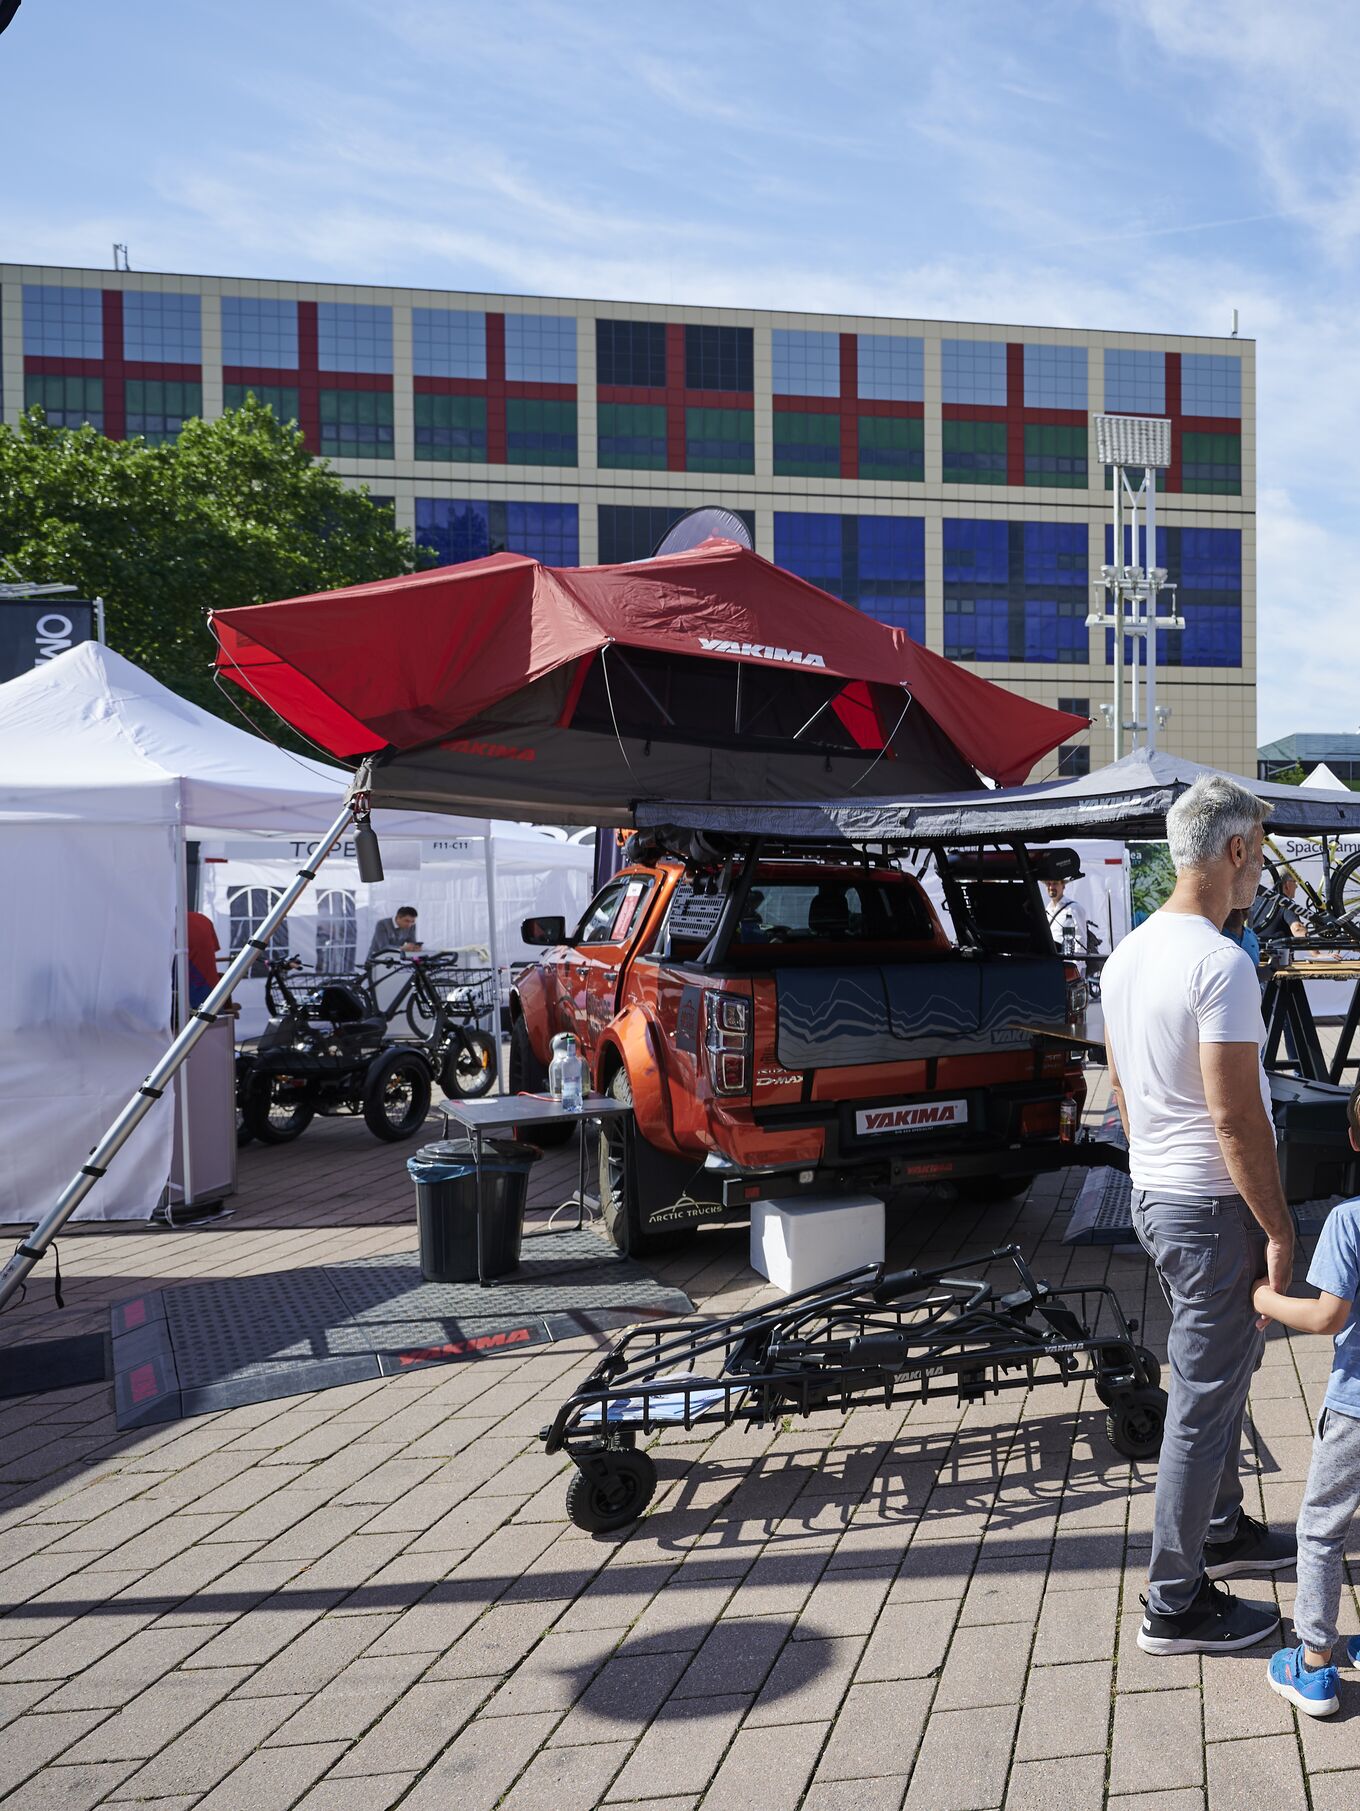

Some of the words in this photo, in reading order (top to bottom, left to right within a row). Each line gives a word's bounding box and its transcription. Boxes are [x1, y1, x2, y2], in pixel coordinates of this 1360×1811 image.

[698, 638, 825, 667] YAKIMA
[433, 842, 468, 850] F11-C11
[864, 1105, 955, 1130] YAKIMA
[649, 1211, 683, 1223] ARCTIC
[687, 1205, 723, 1217] TRUCKS
[399, 1329, 530, 1366] YAKIMA
[1044, 1343, 1084, 1353] YAKIMA
[893, 1365, 944, 1383] YAKIMA
